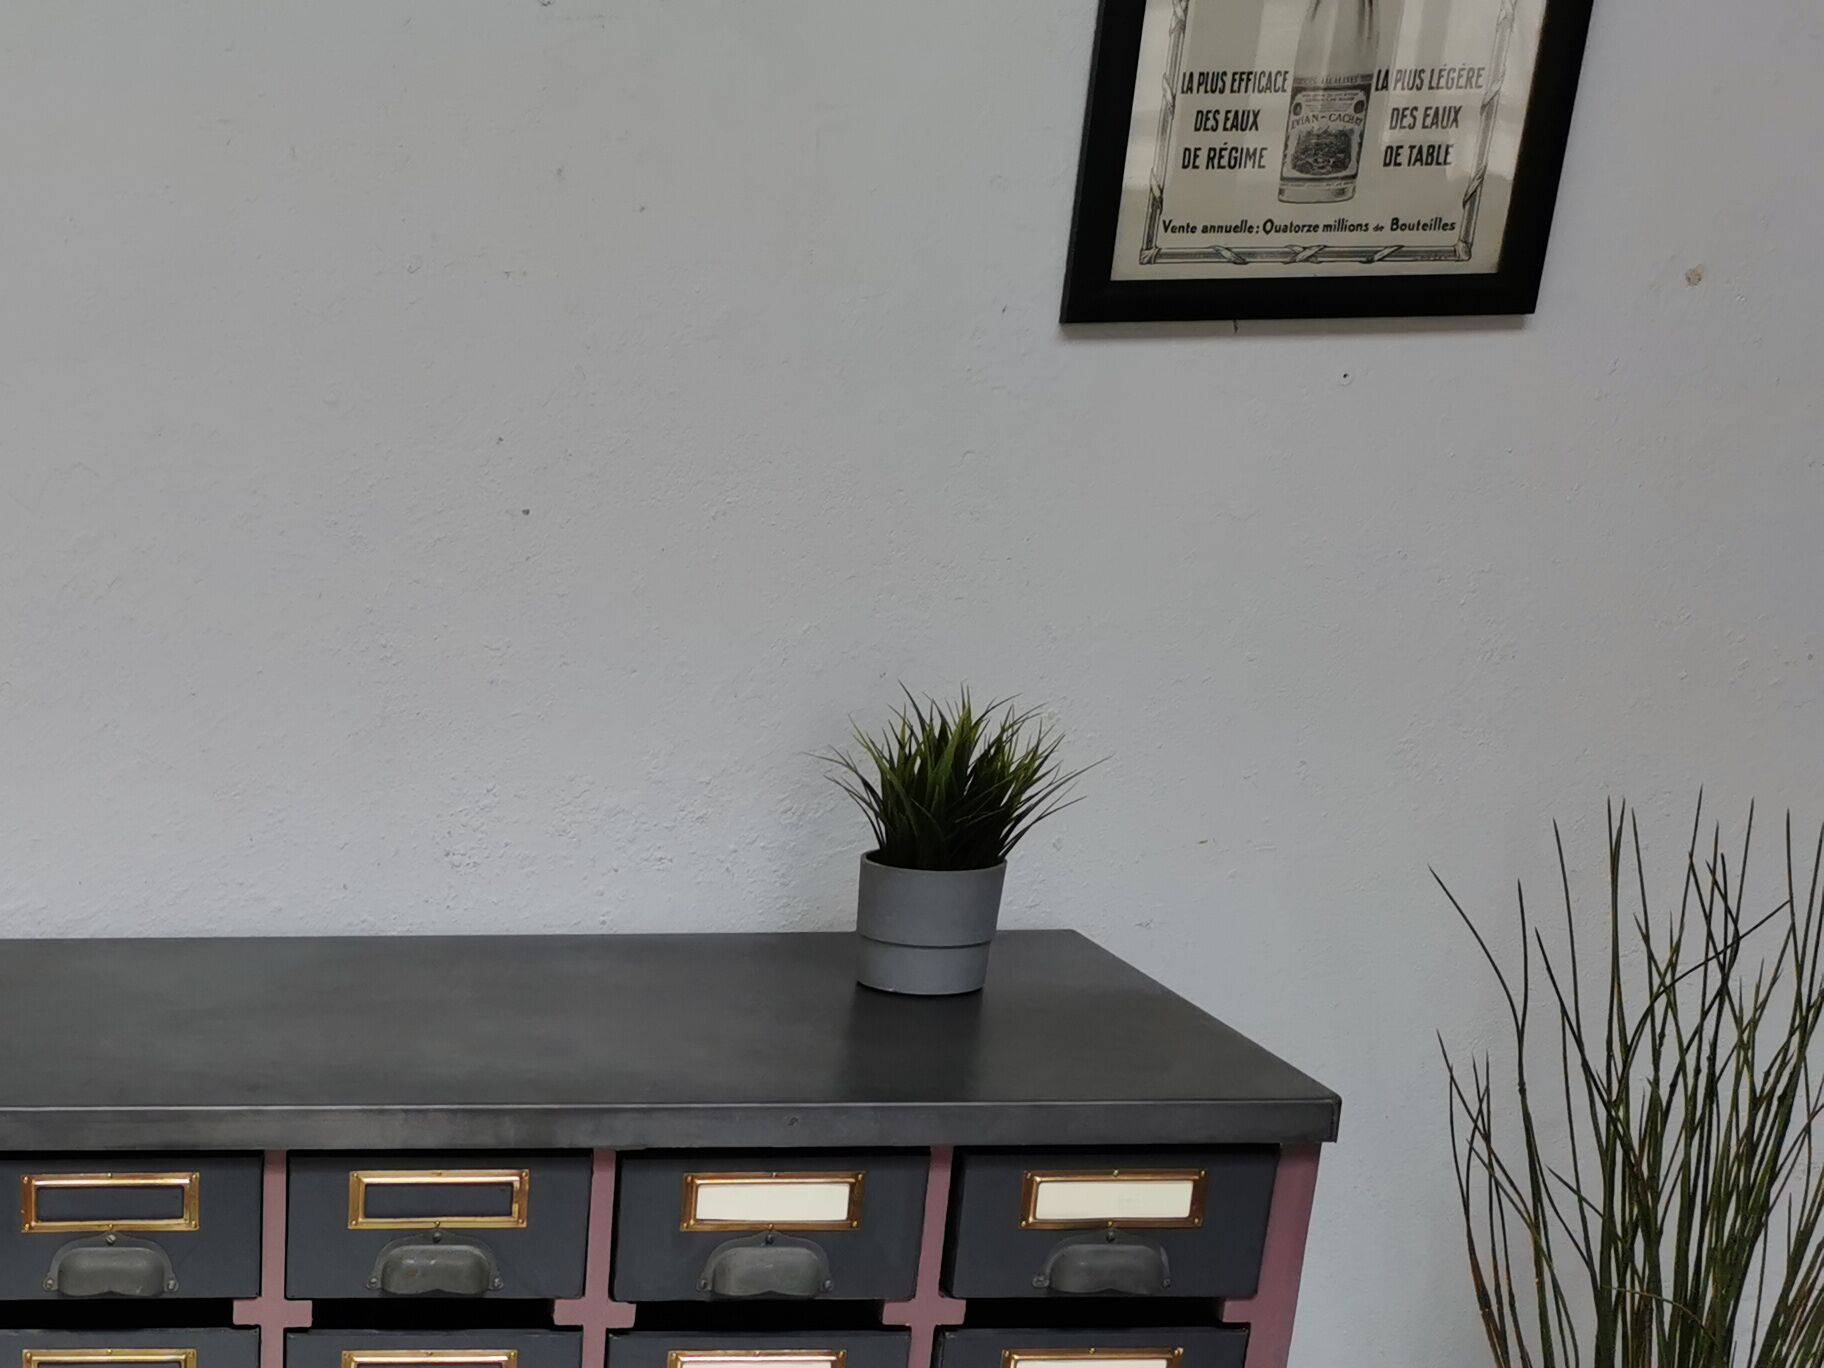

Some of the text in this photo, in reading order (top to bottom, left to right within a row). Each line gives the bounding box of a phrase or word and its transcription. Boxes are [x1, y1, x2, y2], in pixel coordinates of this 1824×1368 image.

[1181, 71, 1194, 94] LA
[1197, 71, 1228, 94] PLUS
[1230, 70, 1289, 94] EFFICACE
[1375, 68, 1390, 92] LA
[1393, 68, 1425, 91] PLUS
[1194, 108, 1261, 132] DES EAUX
[1389, 105, 1462, 130] DES EAUX
[1182, 142, 1268, 170] DE RÉGIME
[1382, 143, 1454, 168] DE TABLE
[1162, 219, 1197, 234] Vente
[1262, 218, 1319, 235] Quatorze
[1322, 218, 1369, 233] millions
[1390, 217, 1456, 232] Bouteilles
